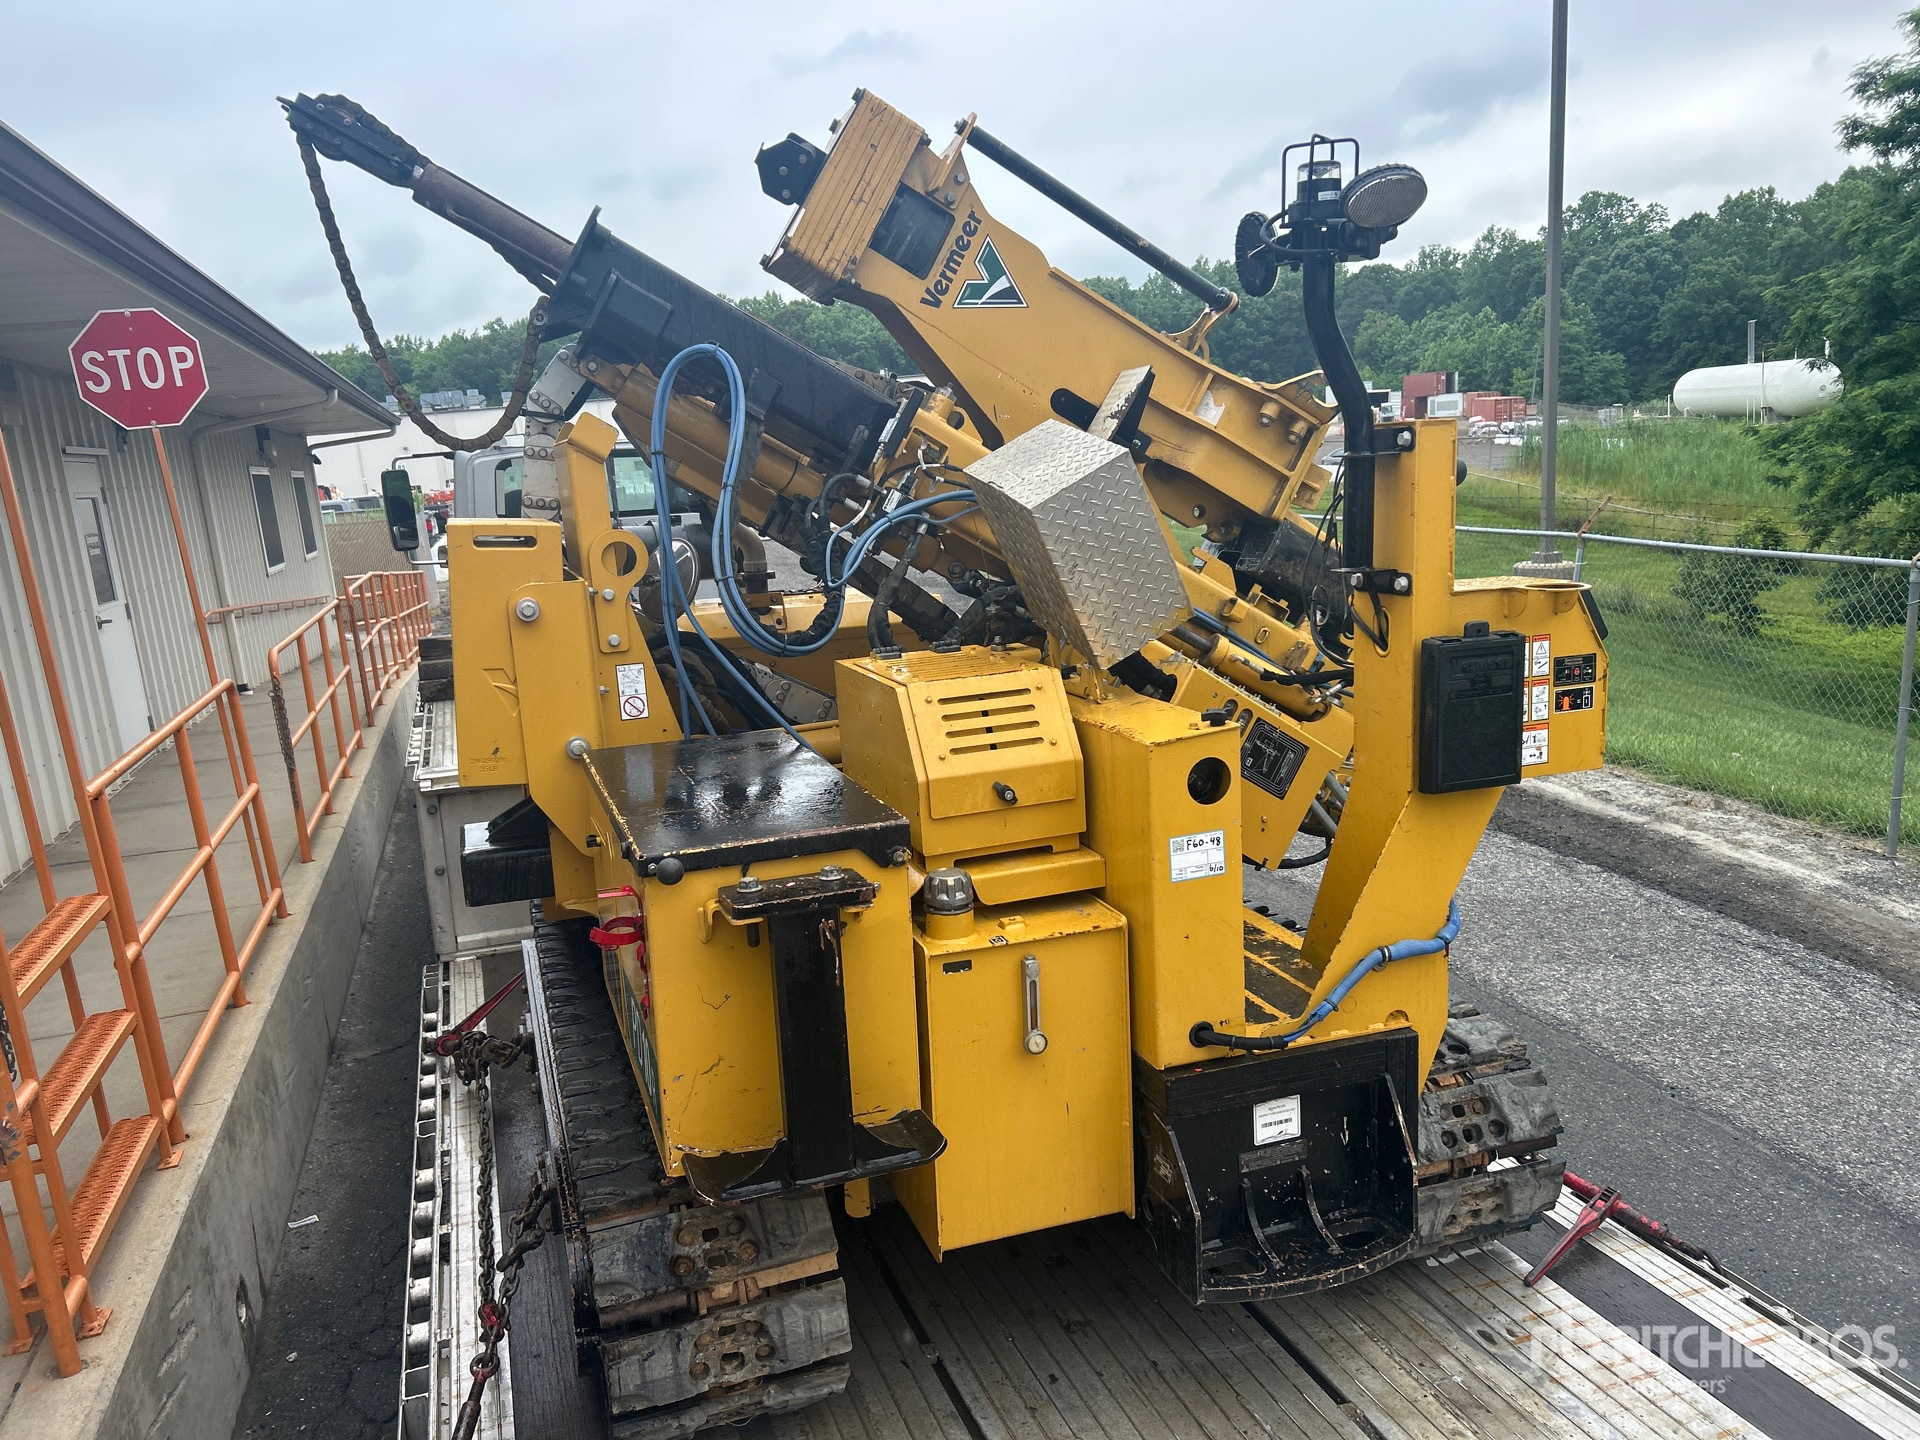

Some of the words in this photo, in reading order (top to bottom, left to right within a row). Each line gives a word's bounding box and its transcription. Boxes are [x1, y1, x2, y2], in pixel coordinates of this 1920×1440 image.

[919, 209, 982, 309] Vermeer
[81, 345, 195, 394] STOP
[1186, 836, 1221, 851] F60-48
